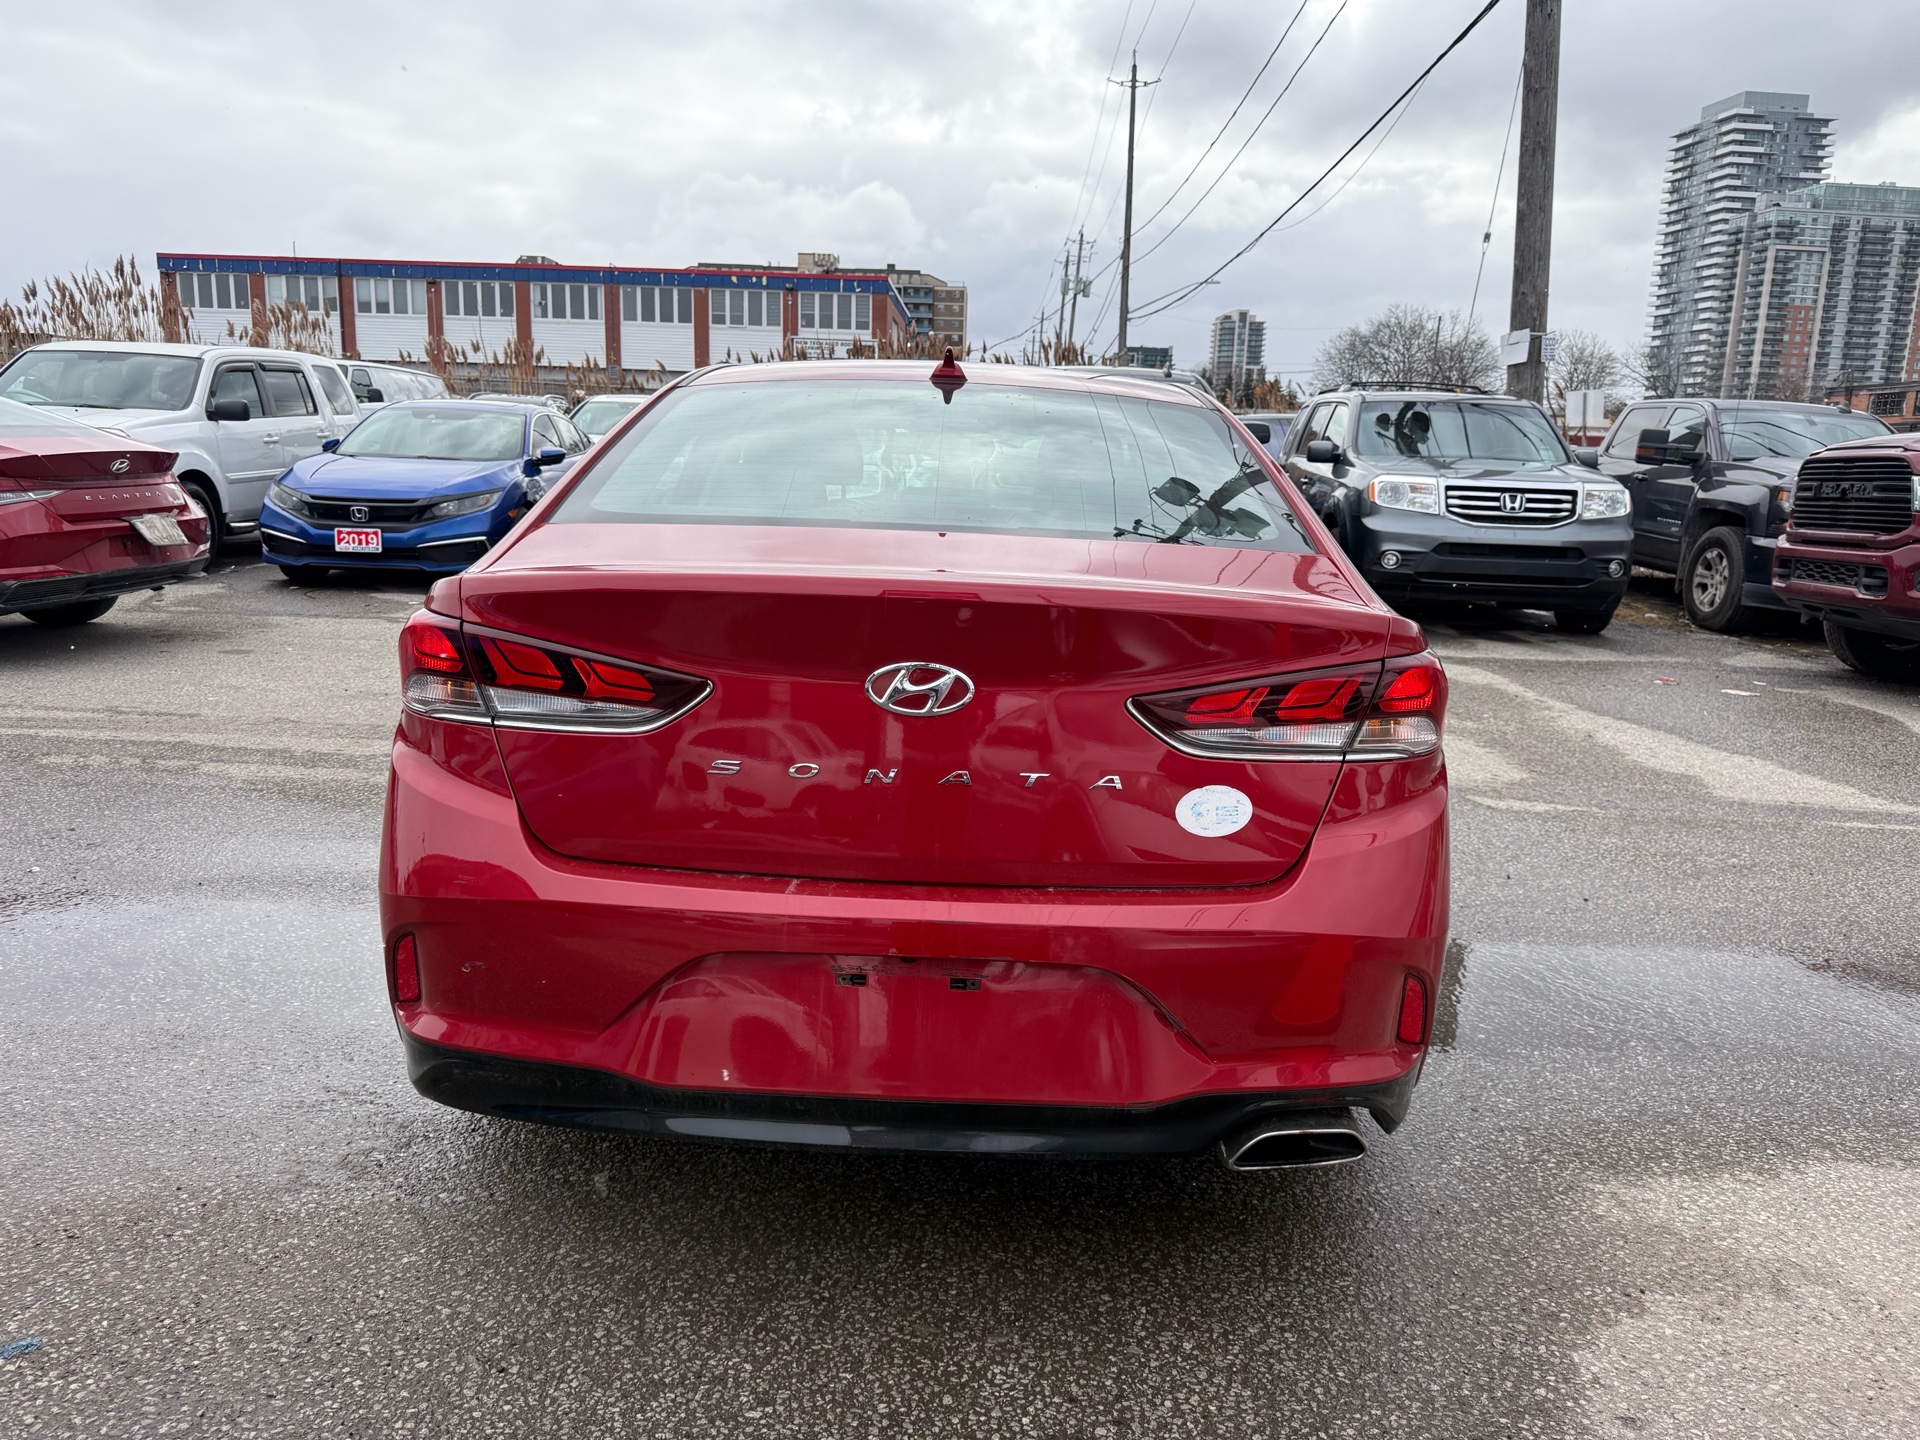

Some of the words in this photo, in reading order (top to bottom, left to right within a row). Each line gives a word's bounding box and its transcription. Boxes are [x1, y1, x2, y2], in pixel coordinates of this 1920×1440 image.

[85, 491, 162, 500] ELANTRA
[339, 533, 377, 546] 2019
[706, 759, 1123, 791] SONATA
